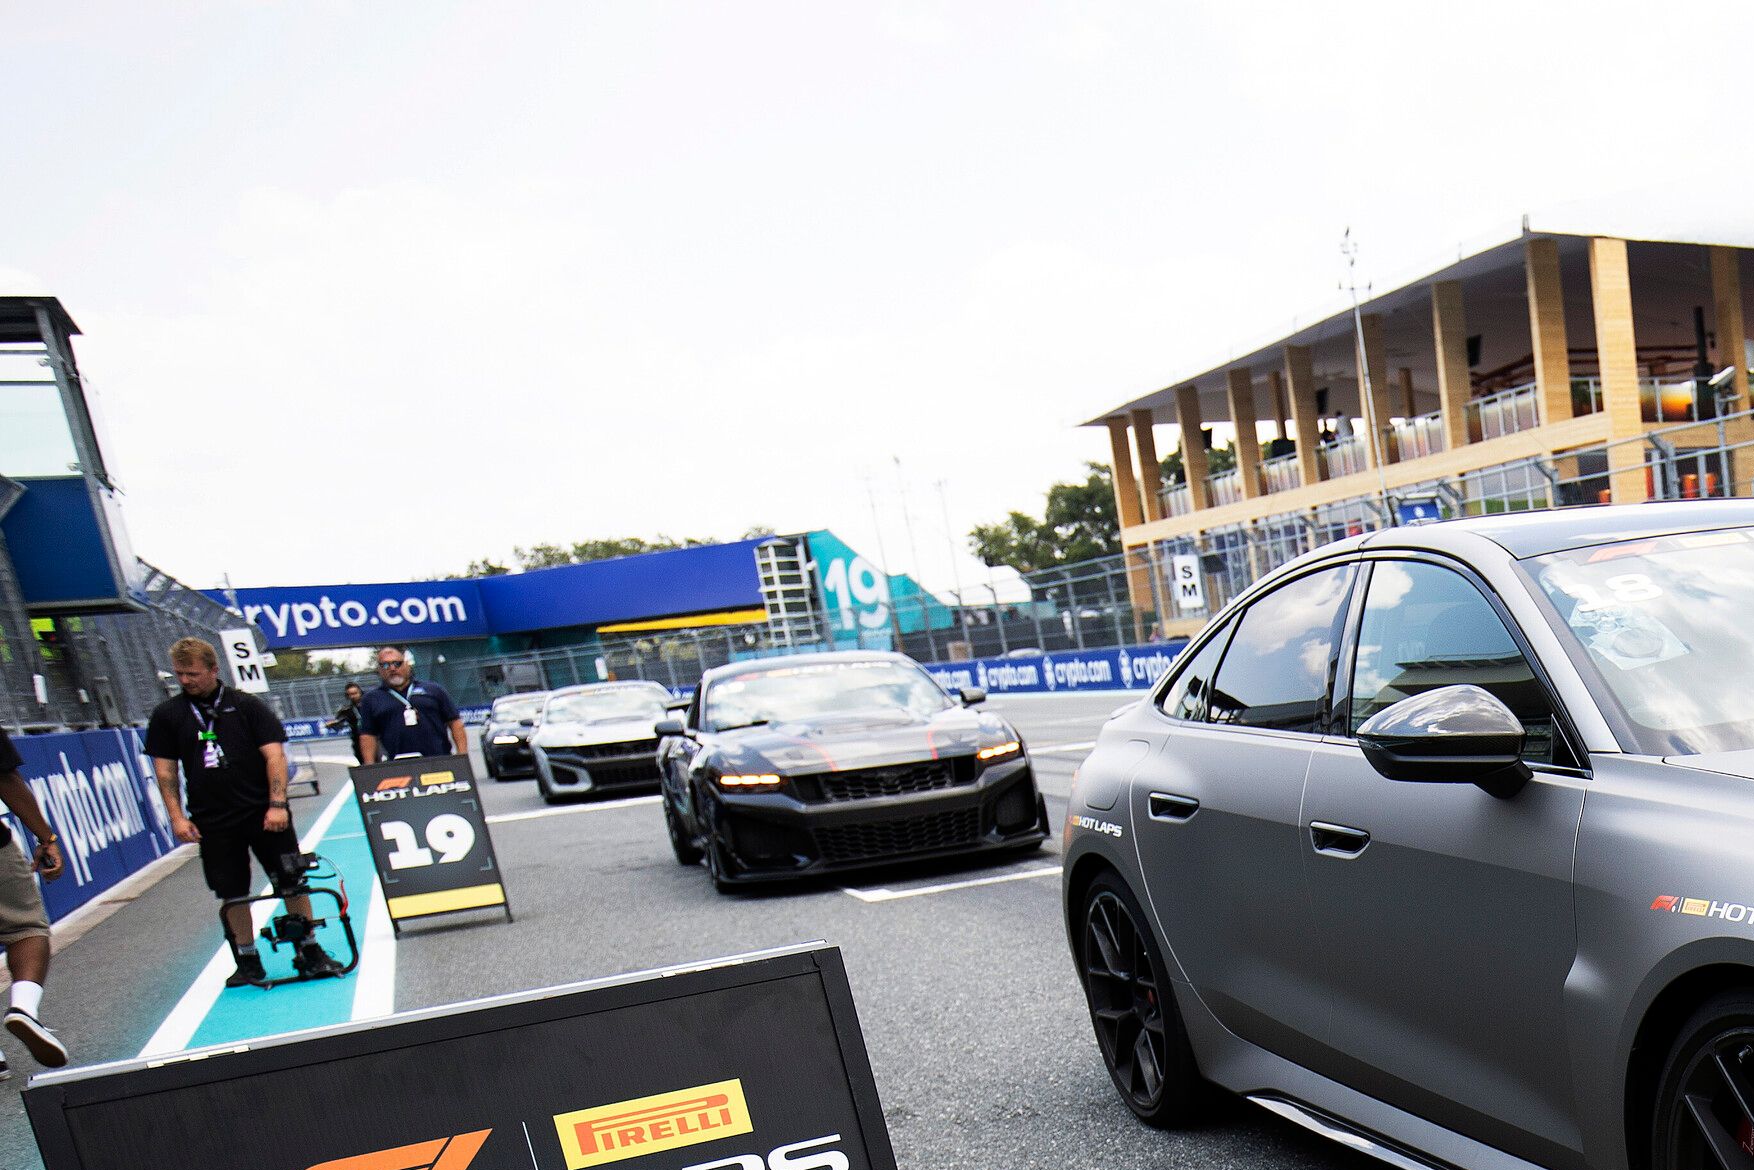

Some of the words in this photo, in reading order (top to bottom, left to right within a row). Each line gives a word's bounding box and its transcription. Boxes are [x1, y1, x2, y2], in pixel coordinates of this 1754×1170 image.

[824, 556, 889, 630] 19
[1563, 573, 1663, 613] 18
[234, 642, 250, 659] S
[240, 665, 261, 682] M
[362, 788, 410, 803] HOT
[412, 781, 472, 797] LAPS
[380, 813, 476, 870] 19
[1094, 819, 1123, 838] LAPS
[573, 1092, 733, 1157] PIRELLI
